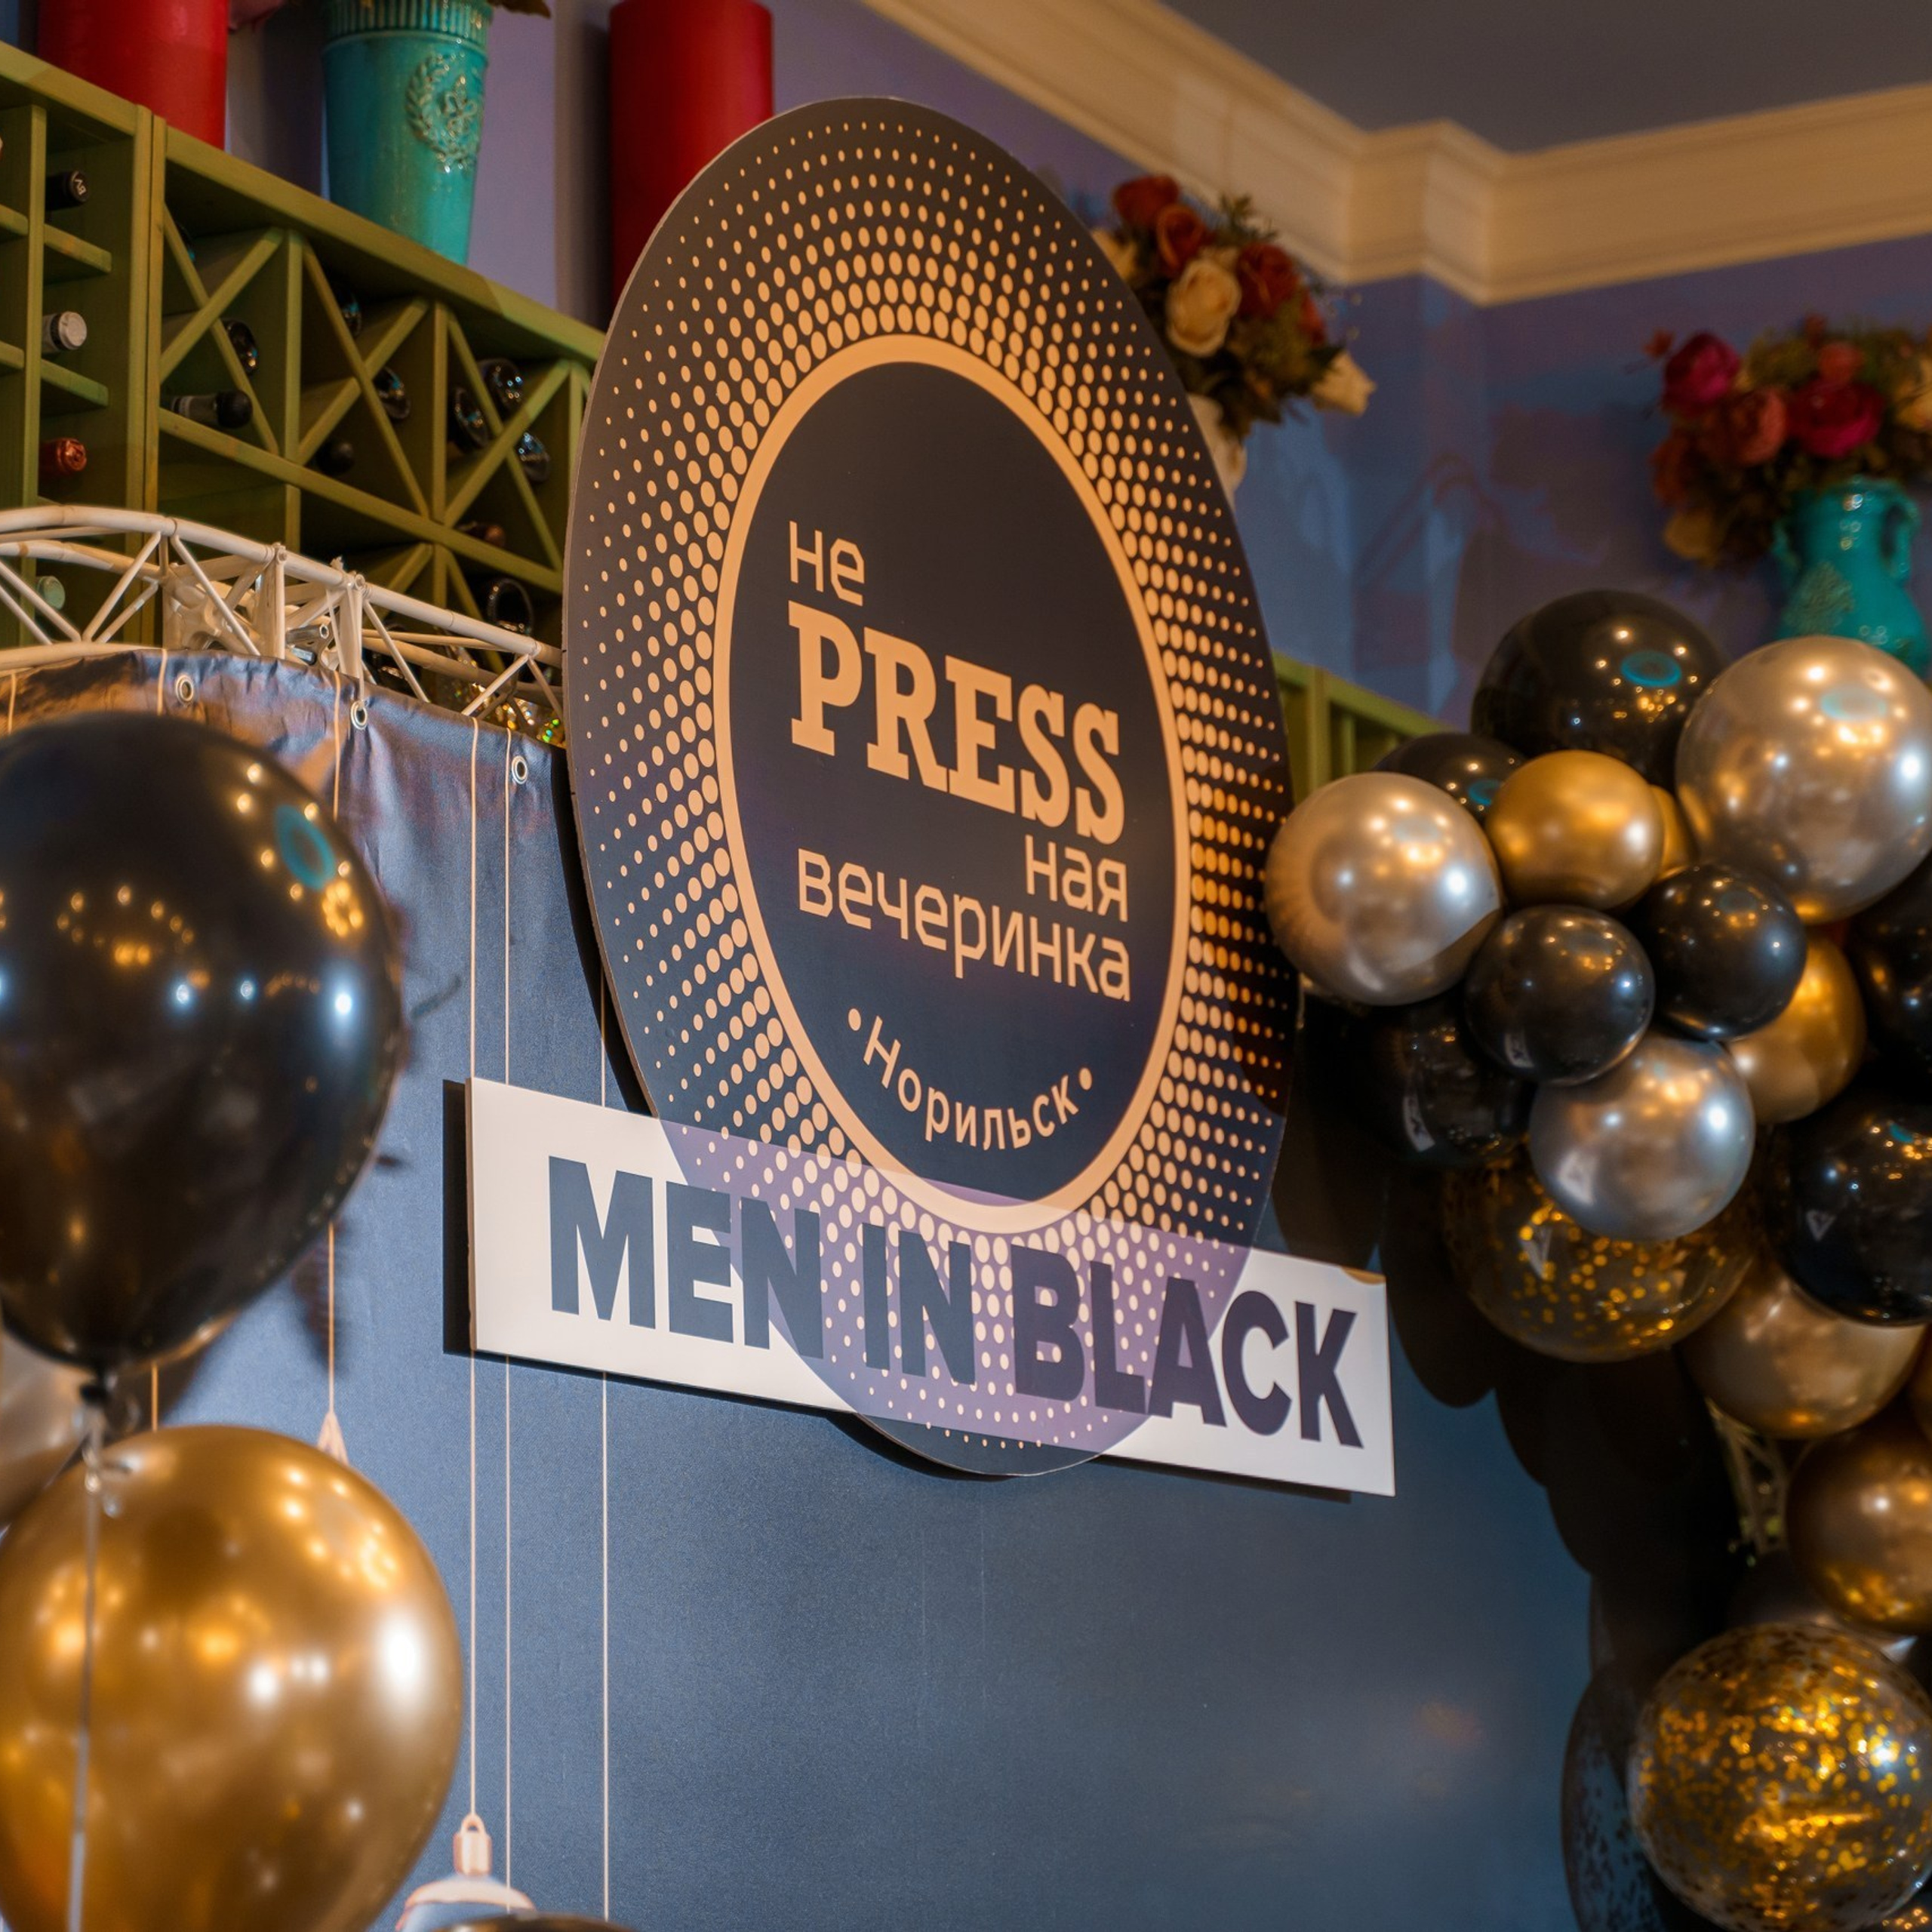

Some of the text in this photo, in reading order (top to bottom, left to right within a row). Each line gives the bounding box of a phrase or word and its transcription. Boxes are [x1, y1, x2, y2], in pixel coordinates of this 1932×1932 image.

[789, 521, 865, 606] не
[788, 600, 1124, 844] PRESS
[798, 848, 1131, 1002] вечеринка
[1025, 834, 1128, 922] ная
[863, 1015, 1078, 1151] Норильск
[549, 1155, 1364, 1449] MEN IN BLACK
